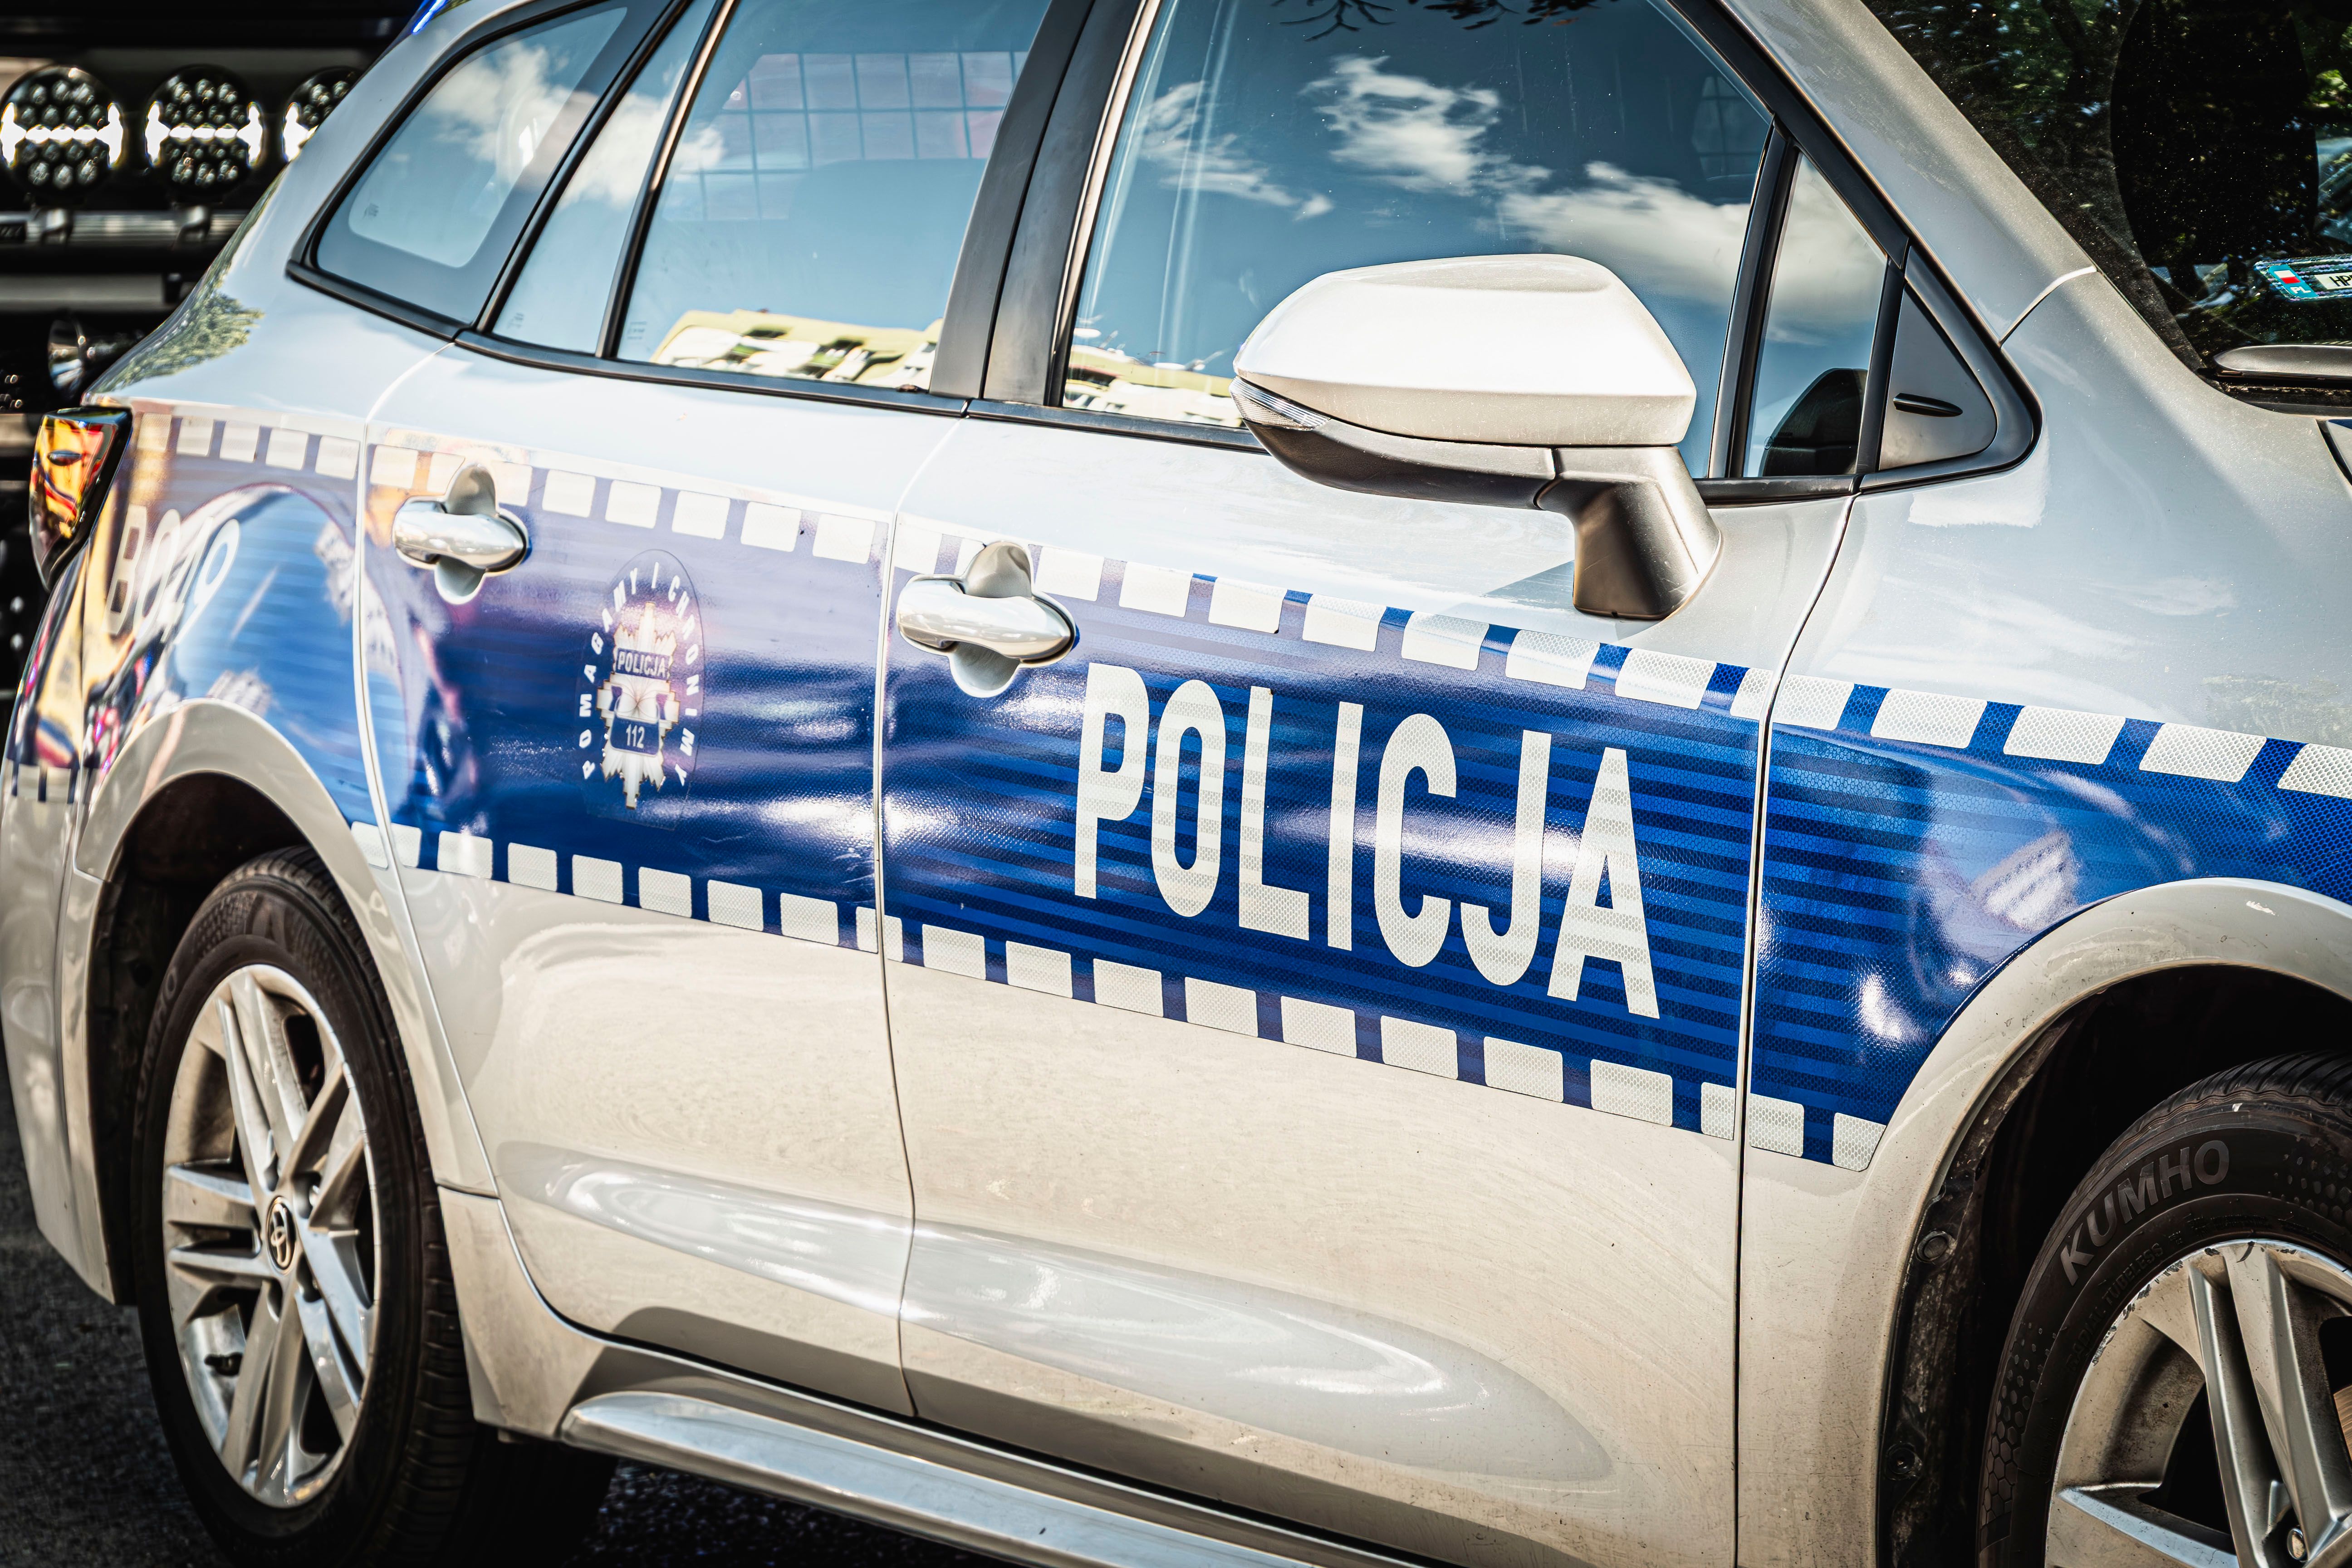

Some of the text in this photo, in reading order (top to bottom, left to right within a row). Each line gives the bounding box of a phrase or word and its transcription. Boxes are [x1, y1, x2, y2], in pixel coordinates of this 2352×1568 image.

[2329, 275, 2352, 287] HP
[101, 503, 240, 645] B049
[579, 562, 699, 785] POMAGAMY I CHRONIMY
[617, 651, 666, 678] POLICJA
[626, 724, 645, 749] 112
[1074, 662, 1660, 1019] POLICJA
[2059, 1140, 2230, 1286] KUMHO
[2102, 1242, 2164, 1304] TUBELESS
